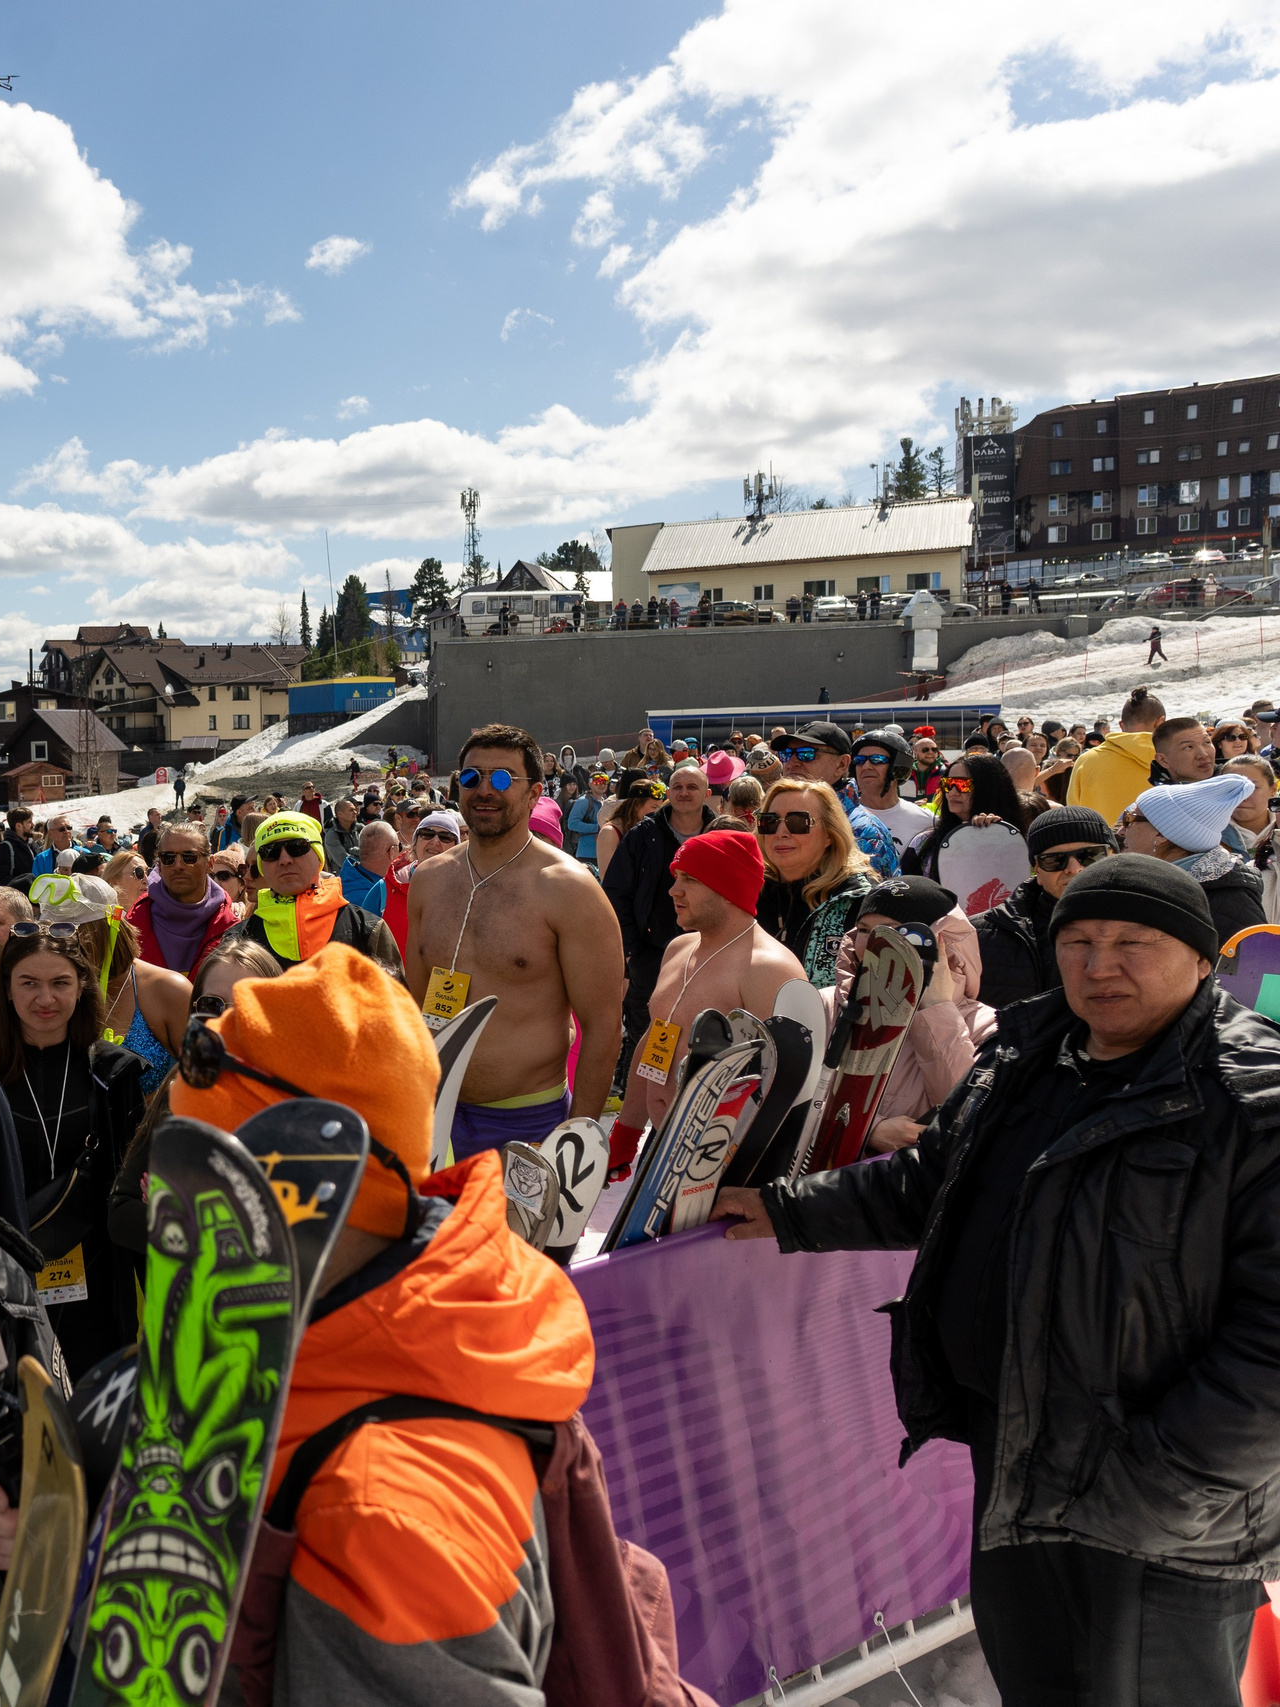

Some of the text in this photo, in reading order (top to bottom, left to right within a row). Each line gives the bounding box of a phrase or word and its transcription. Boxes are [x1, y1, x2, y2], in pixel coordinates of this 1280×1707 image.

[973, 447, 1006, 457] ОЛЬГА
[261, 826, 308, 840] ELBRUS
[434, 1002, 453, 1014] 852
[650, 1053, 664, 1064] 703
[643, 1064, 740, 1239] FISCHER
[681, 1182, 715, 1197] ROSSIGNOL
[49, 1270, 71, 1281] 274
